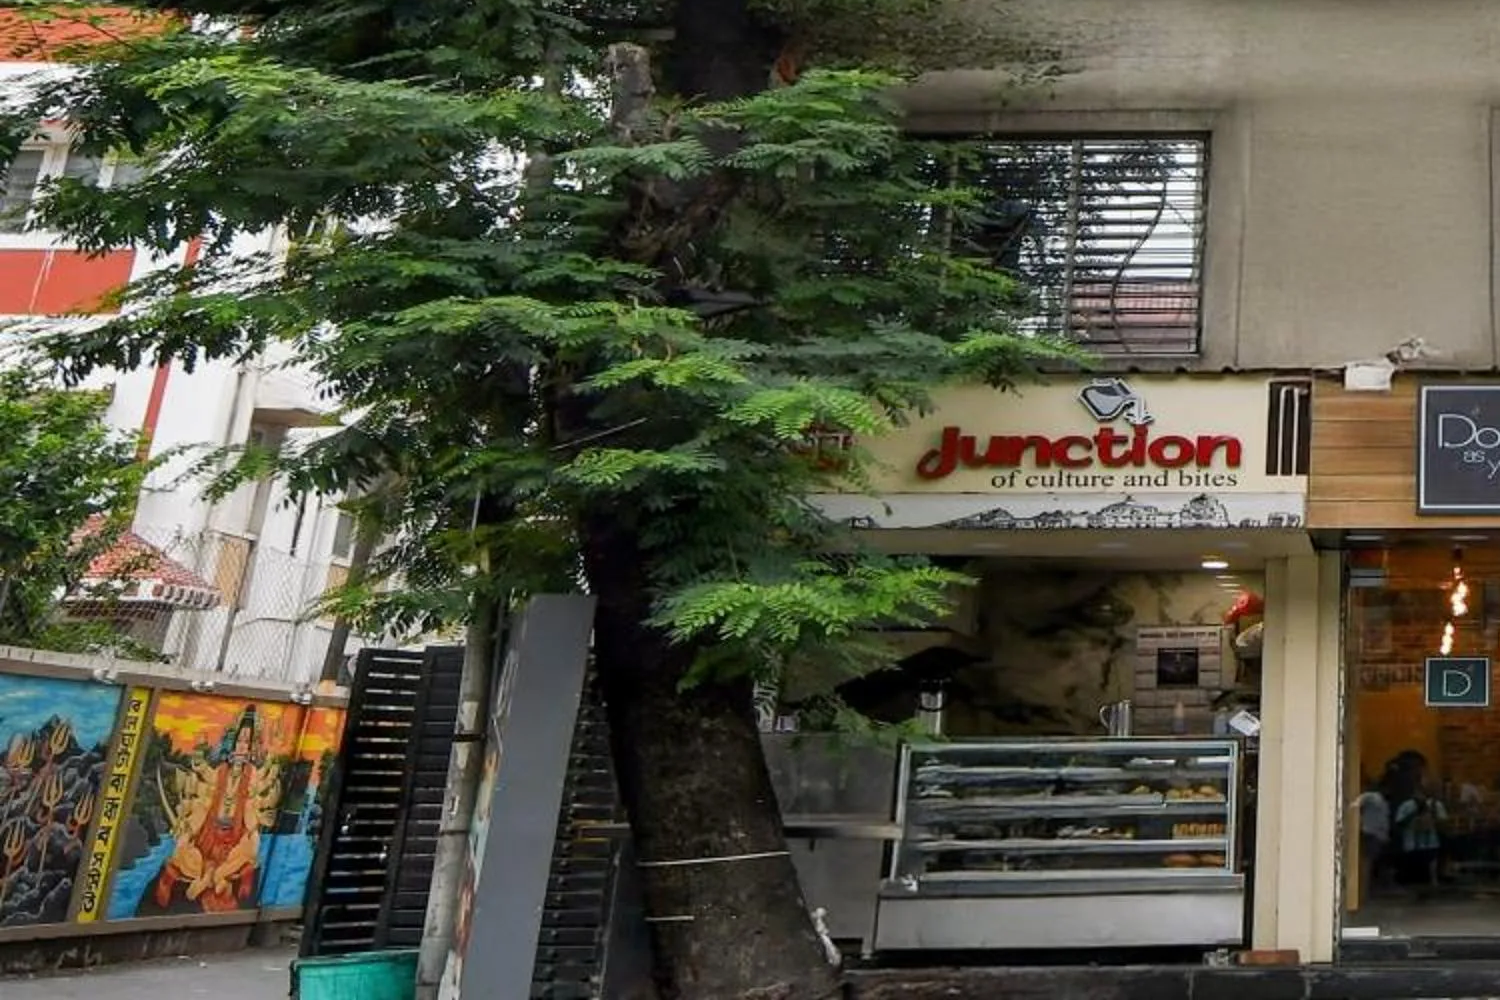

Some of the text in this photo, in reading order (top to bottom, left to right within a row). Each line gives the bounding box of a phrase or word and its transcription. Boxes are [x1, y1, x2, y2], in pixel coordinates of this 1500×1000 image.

[1463, 450, 1486, 464] as
[991, 469, 1238, 489] of culture and bites
